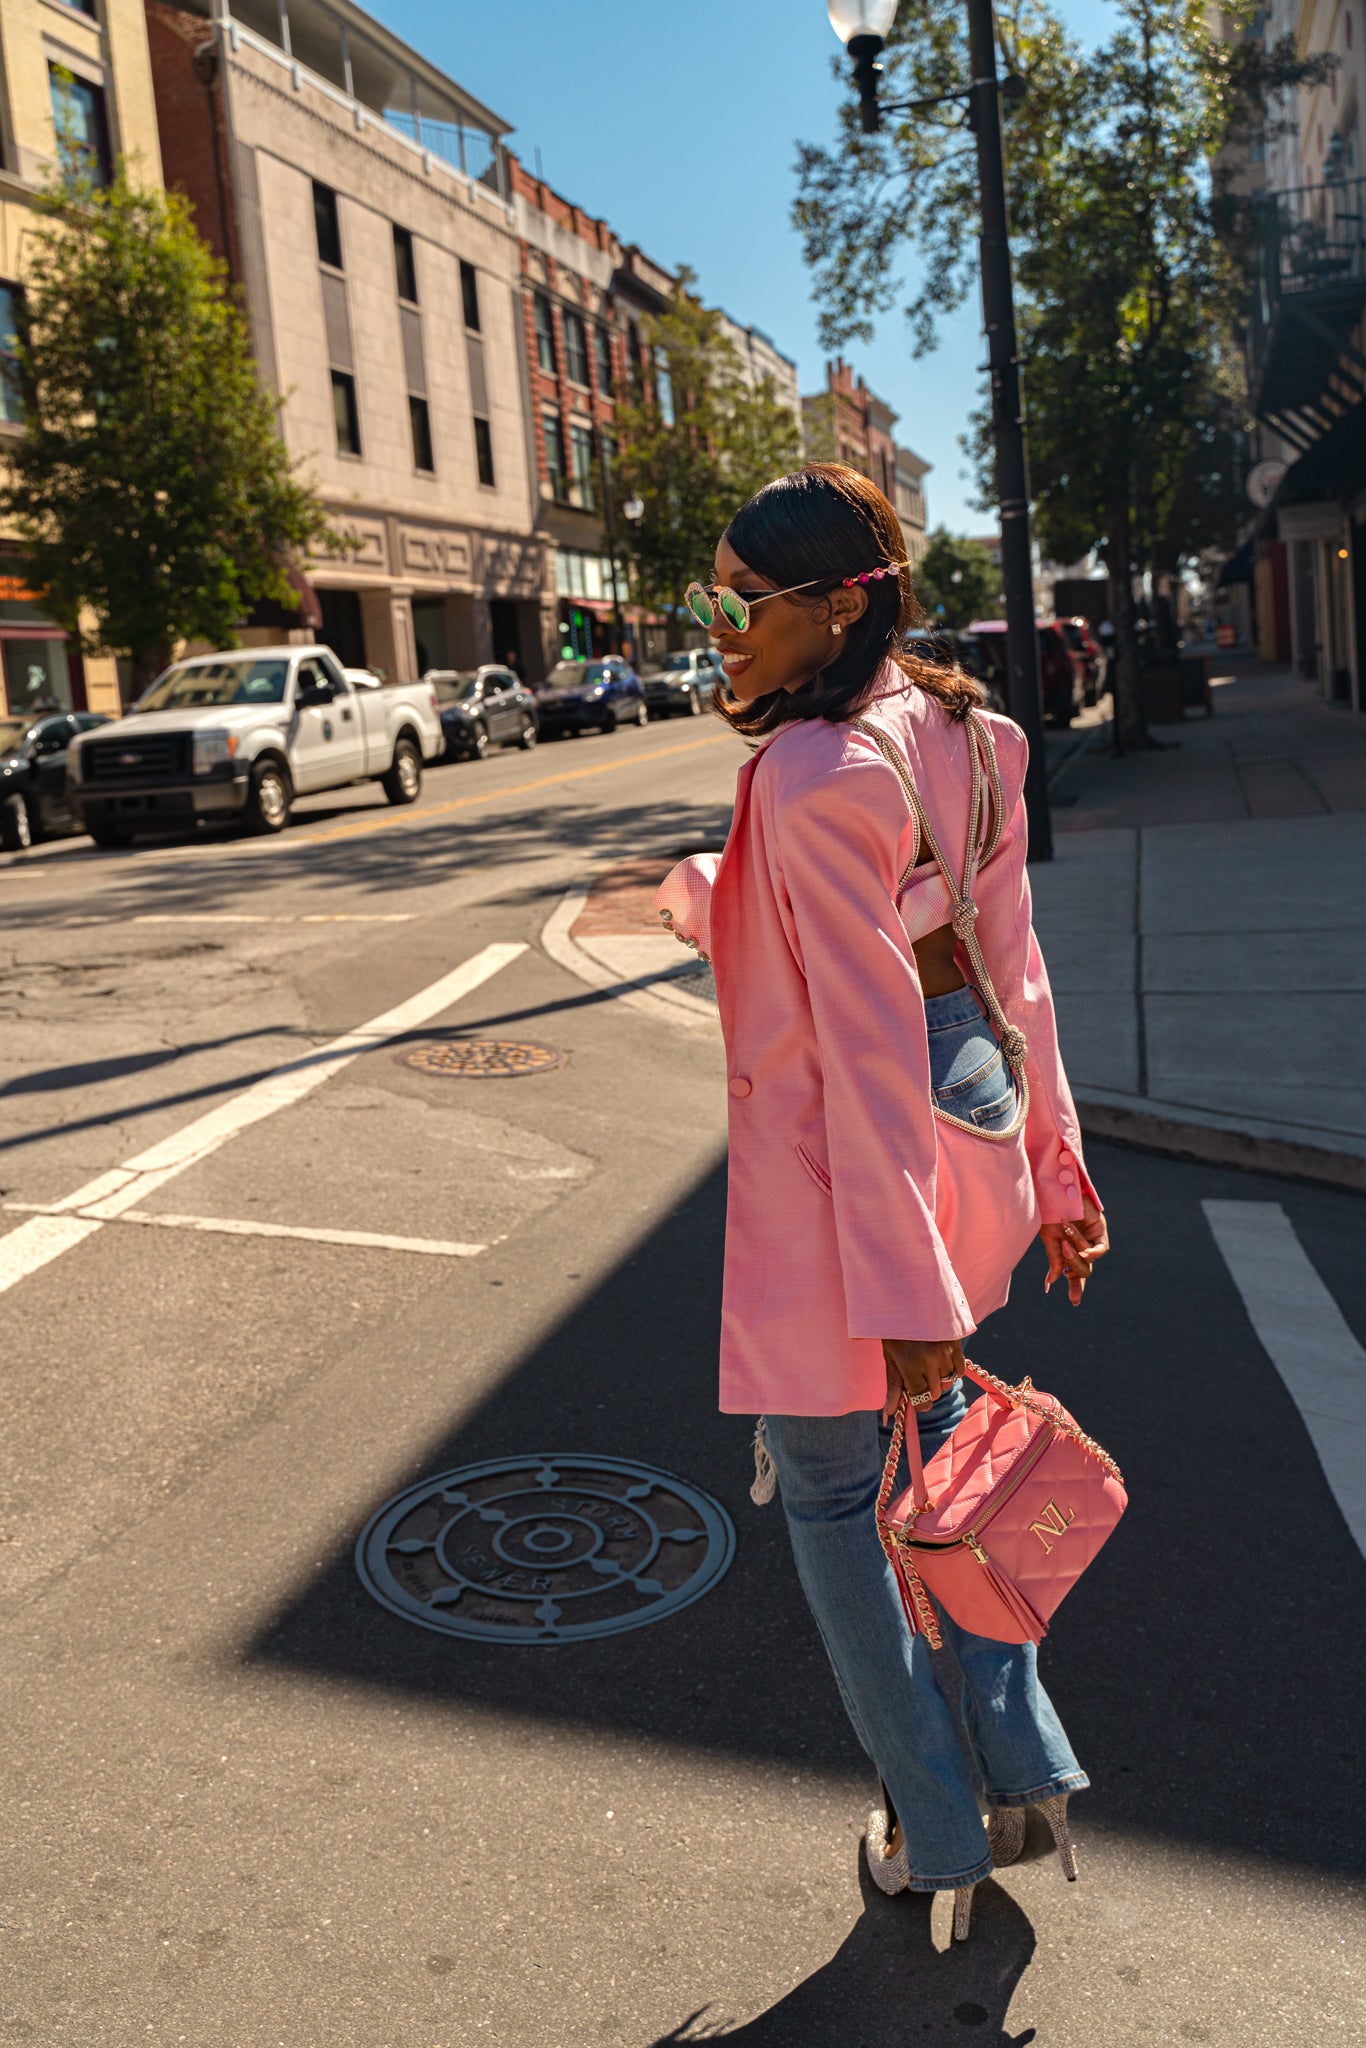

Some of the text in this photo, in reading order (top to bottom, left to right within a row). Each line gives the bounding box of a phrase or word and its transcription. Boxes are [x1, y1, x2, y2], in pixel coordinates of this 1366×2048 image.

[550, 1497, 639, 1539] STORM
[1028, 1496, 1077, 1555] NL
[462, 1543, 553, 1591] SEWER
